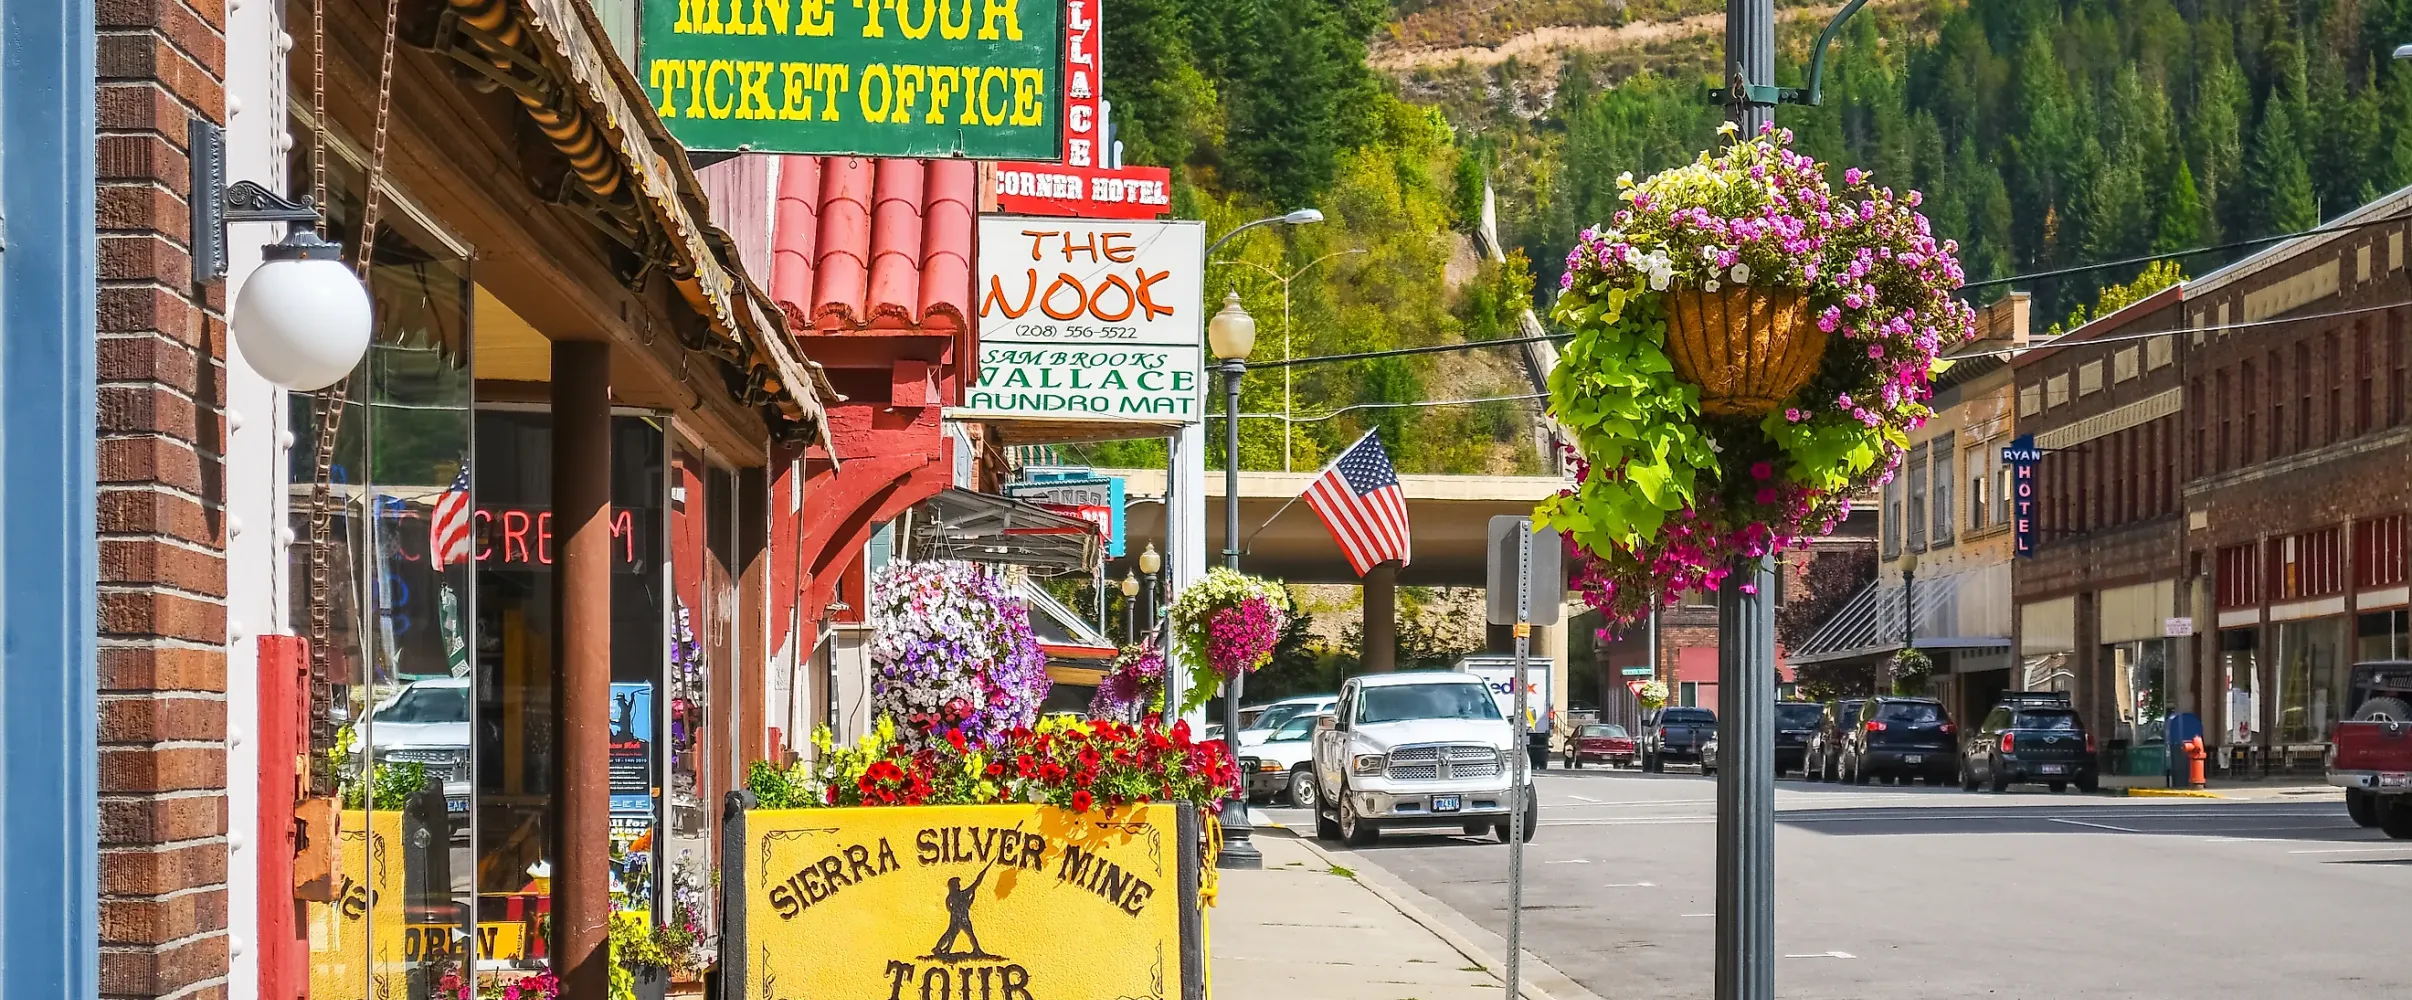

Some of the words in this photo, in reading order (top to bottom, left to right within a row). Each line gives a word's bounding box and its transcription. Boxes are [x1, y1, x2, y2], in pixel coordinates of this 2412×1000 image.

[673, 0, 835, 36] MINE
[853, 0, 1023, 41] TOUR
[650, 59, 849, 122] TICKET
[858, 62, 1044, 126] OFFICE
[1091, 177, 1168, 205] HOTEL
[1021, 230, 1137, 263] THE
[979, 267, 1174, 321] NOOK
[1015, 325, 1057, 338] (208)
[1064, 325, 1138, 339] 556-5522
[981, 349, 1048, 366] SAM
[1050, 352, 1168, 370] BROOKS
[965, 392, 1109, 412] AUNDRO
[1119, 396, 1195, 414] MAT
[2003, 450, 2041, 461] RYAN
[2018, 465, 2031, 551] HOTEL
[474, 509, 633, 564] CREM
[1484, 677, 1538, 695] edx
[768, 837, 901, 920] SIERRA
[916, 825, 1047, 872] SILVER
[1057, 844, 1155, 919] MINE
[884, 959, 1034, 1000] TOUR
